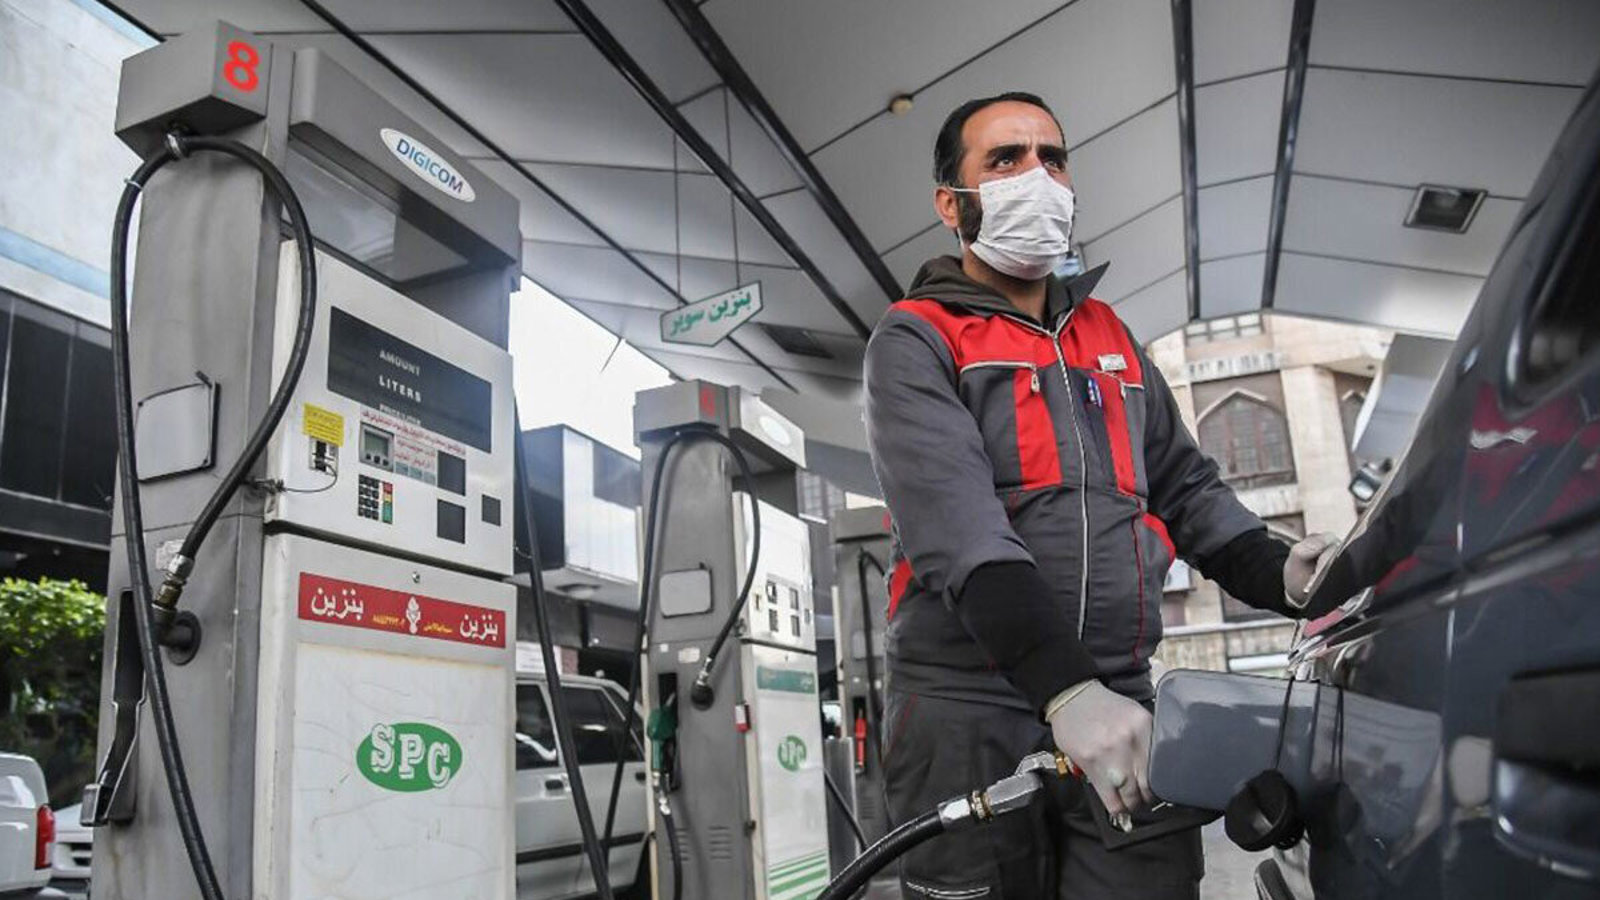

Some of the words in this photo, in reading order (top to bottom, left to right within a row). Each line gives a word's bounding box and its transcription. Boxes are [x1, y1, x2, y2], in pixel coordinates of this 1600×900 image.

[223, 40, 259, 92] 8
[396, 138, 464, 194] DIGICOM
[379, 350, 420, 376] AMOUNT
[379, 375, 421, 402] LITERS
[311, 587, 364, 621] بنزین
[460, 614, 498, 641] بنزین
[371, 723, 450, 789] SPC
